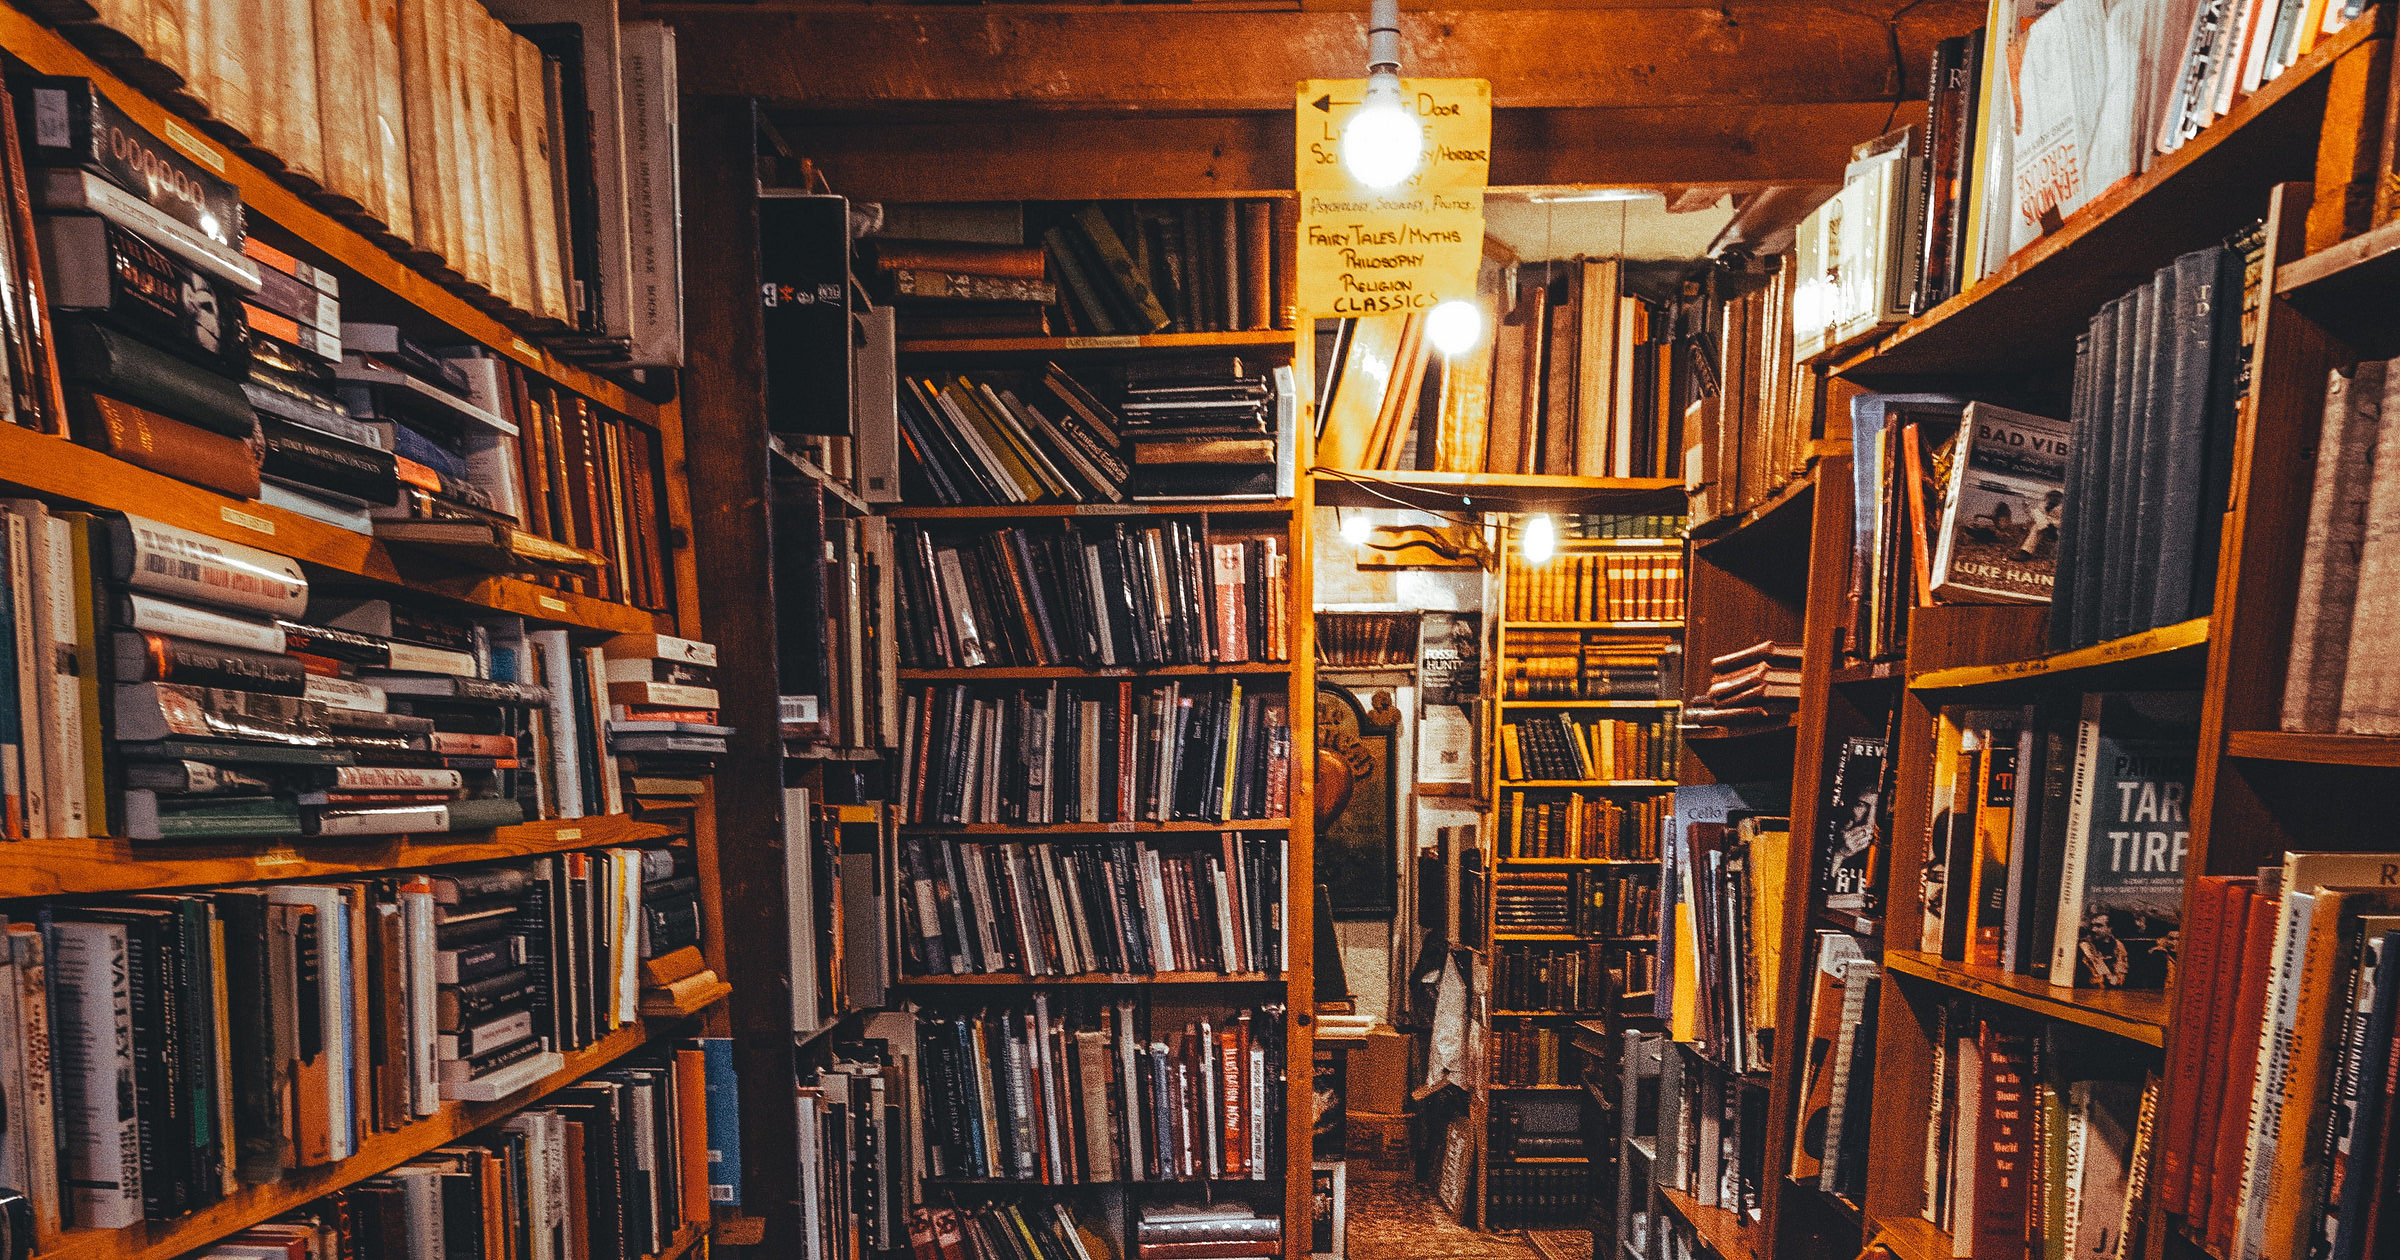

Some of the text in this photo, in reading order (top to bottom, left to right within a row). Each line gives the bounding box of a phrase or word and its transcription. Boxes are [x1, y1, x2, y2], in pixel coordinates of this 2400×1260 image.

[640, 160, 652, 236] IMPORTANT
[1308, 225, 1350, 247] FAIRY
[1338, 247, 1425, 270] PHILOSOPHY
[1338, 273, 1412, 293] RELIGION
[1333, 292, 1440, 314] CLASSICS
[1979, 424, 2068, 457] BAD VIB
[1954, 560, 2055, 588] LUKE HAIN
[1426, 660, 1463, 671] HUNT
[1854, 745, 1884, 757] REV
[2074, 761, 2085, 805] TIRPITZ
[2116, 781, 2186, 823] TAR
[2068, 812, 2080, 859] PATRICK
[2344, 968, 2358, 1004] Small
[110, 954, 130, 1060] VALLEY
[2337, 1005, 2352, 1047] States
[2034, 1084, 2042, 1106] THE
[2328, 1064, 2343, 1105] World
[2032, 1109, 2041, 1141] MAN
